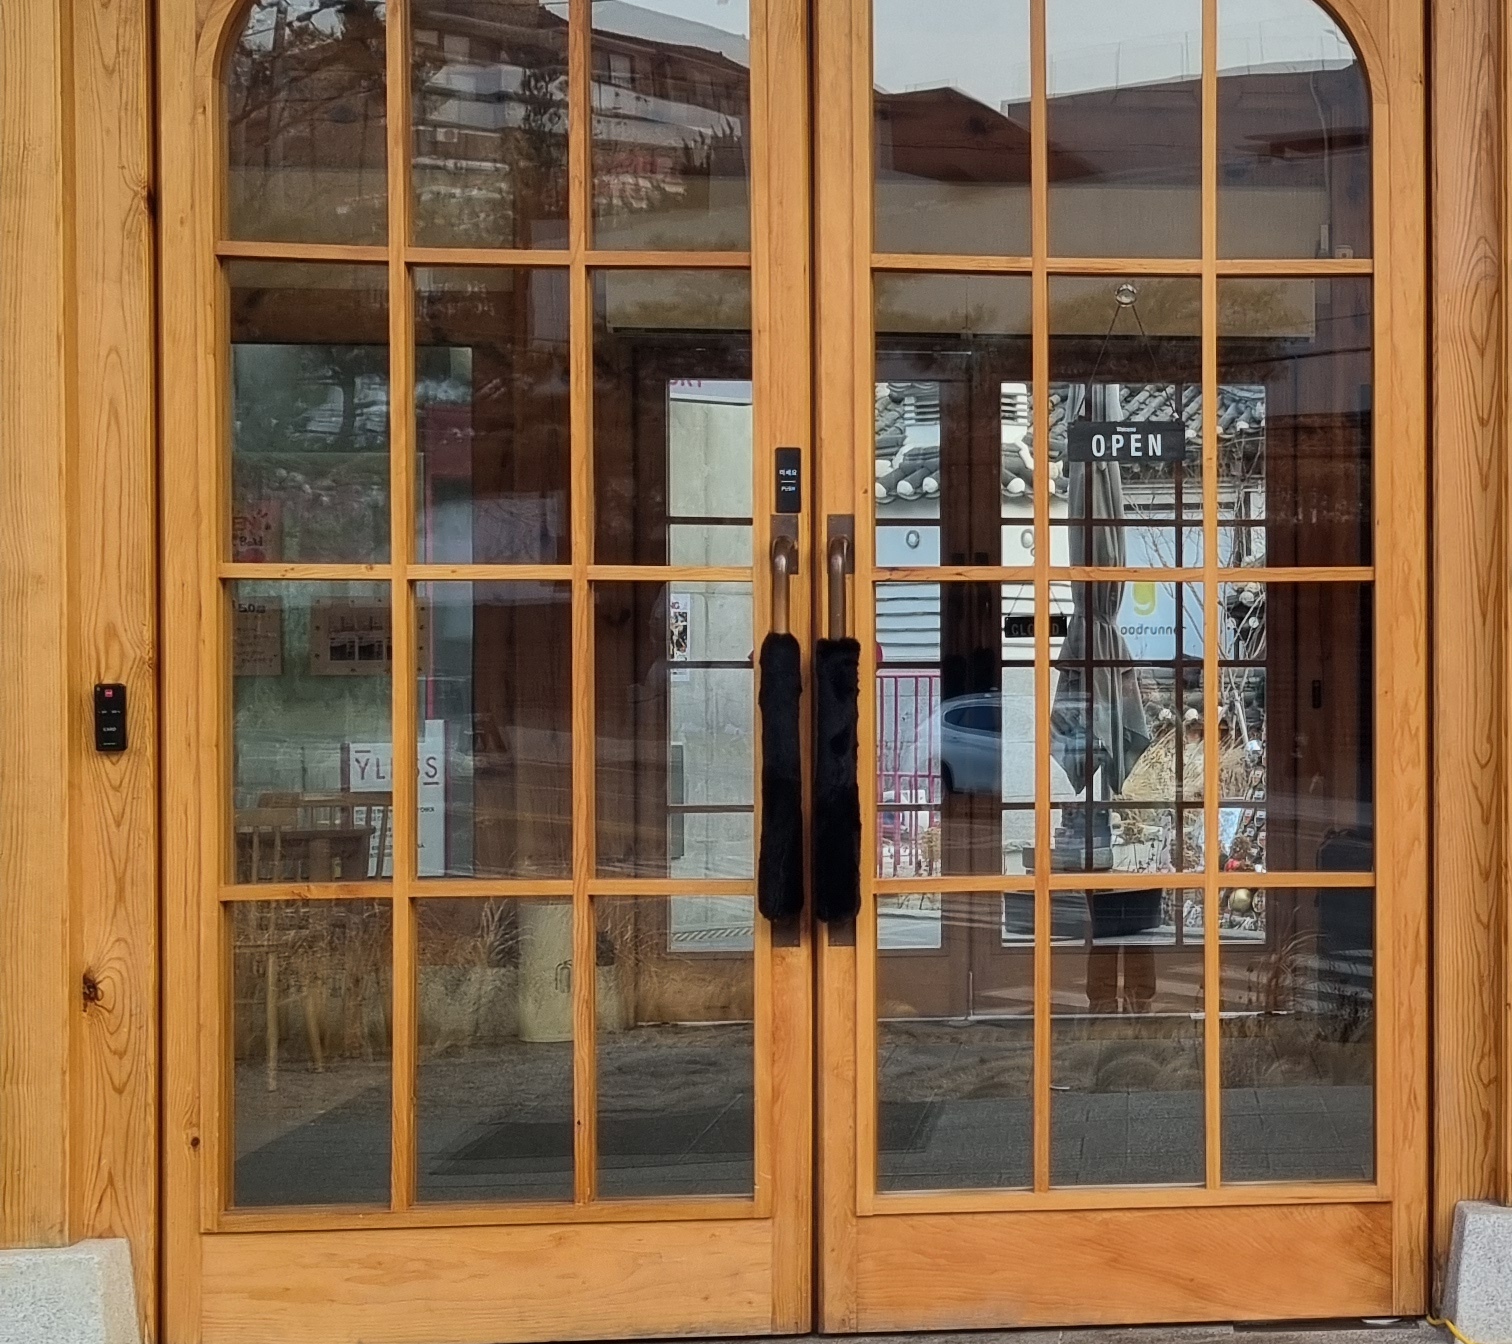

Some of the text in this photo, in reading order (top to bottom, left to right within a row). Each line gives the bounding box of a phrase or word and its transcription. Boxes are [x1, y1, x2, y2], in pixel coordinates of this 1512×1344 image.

[1092, 434, 1162, 457] OPEN
[1011, 624, 1059, 636] CLOD
[355, 756, 438, 781] YLS
